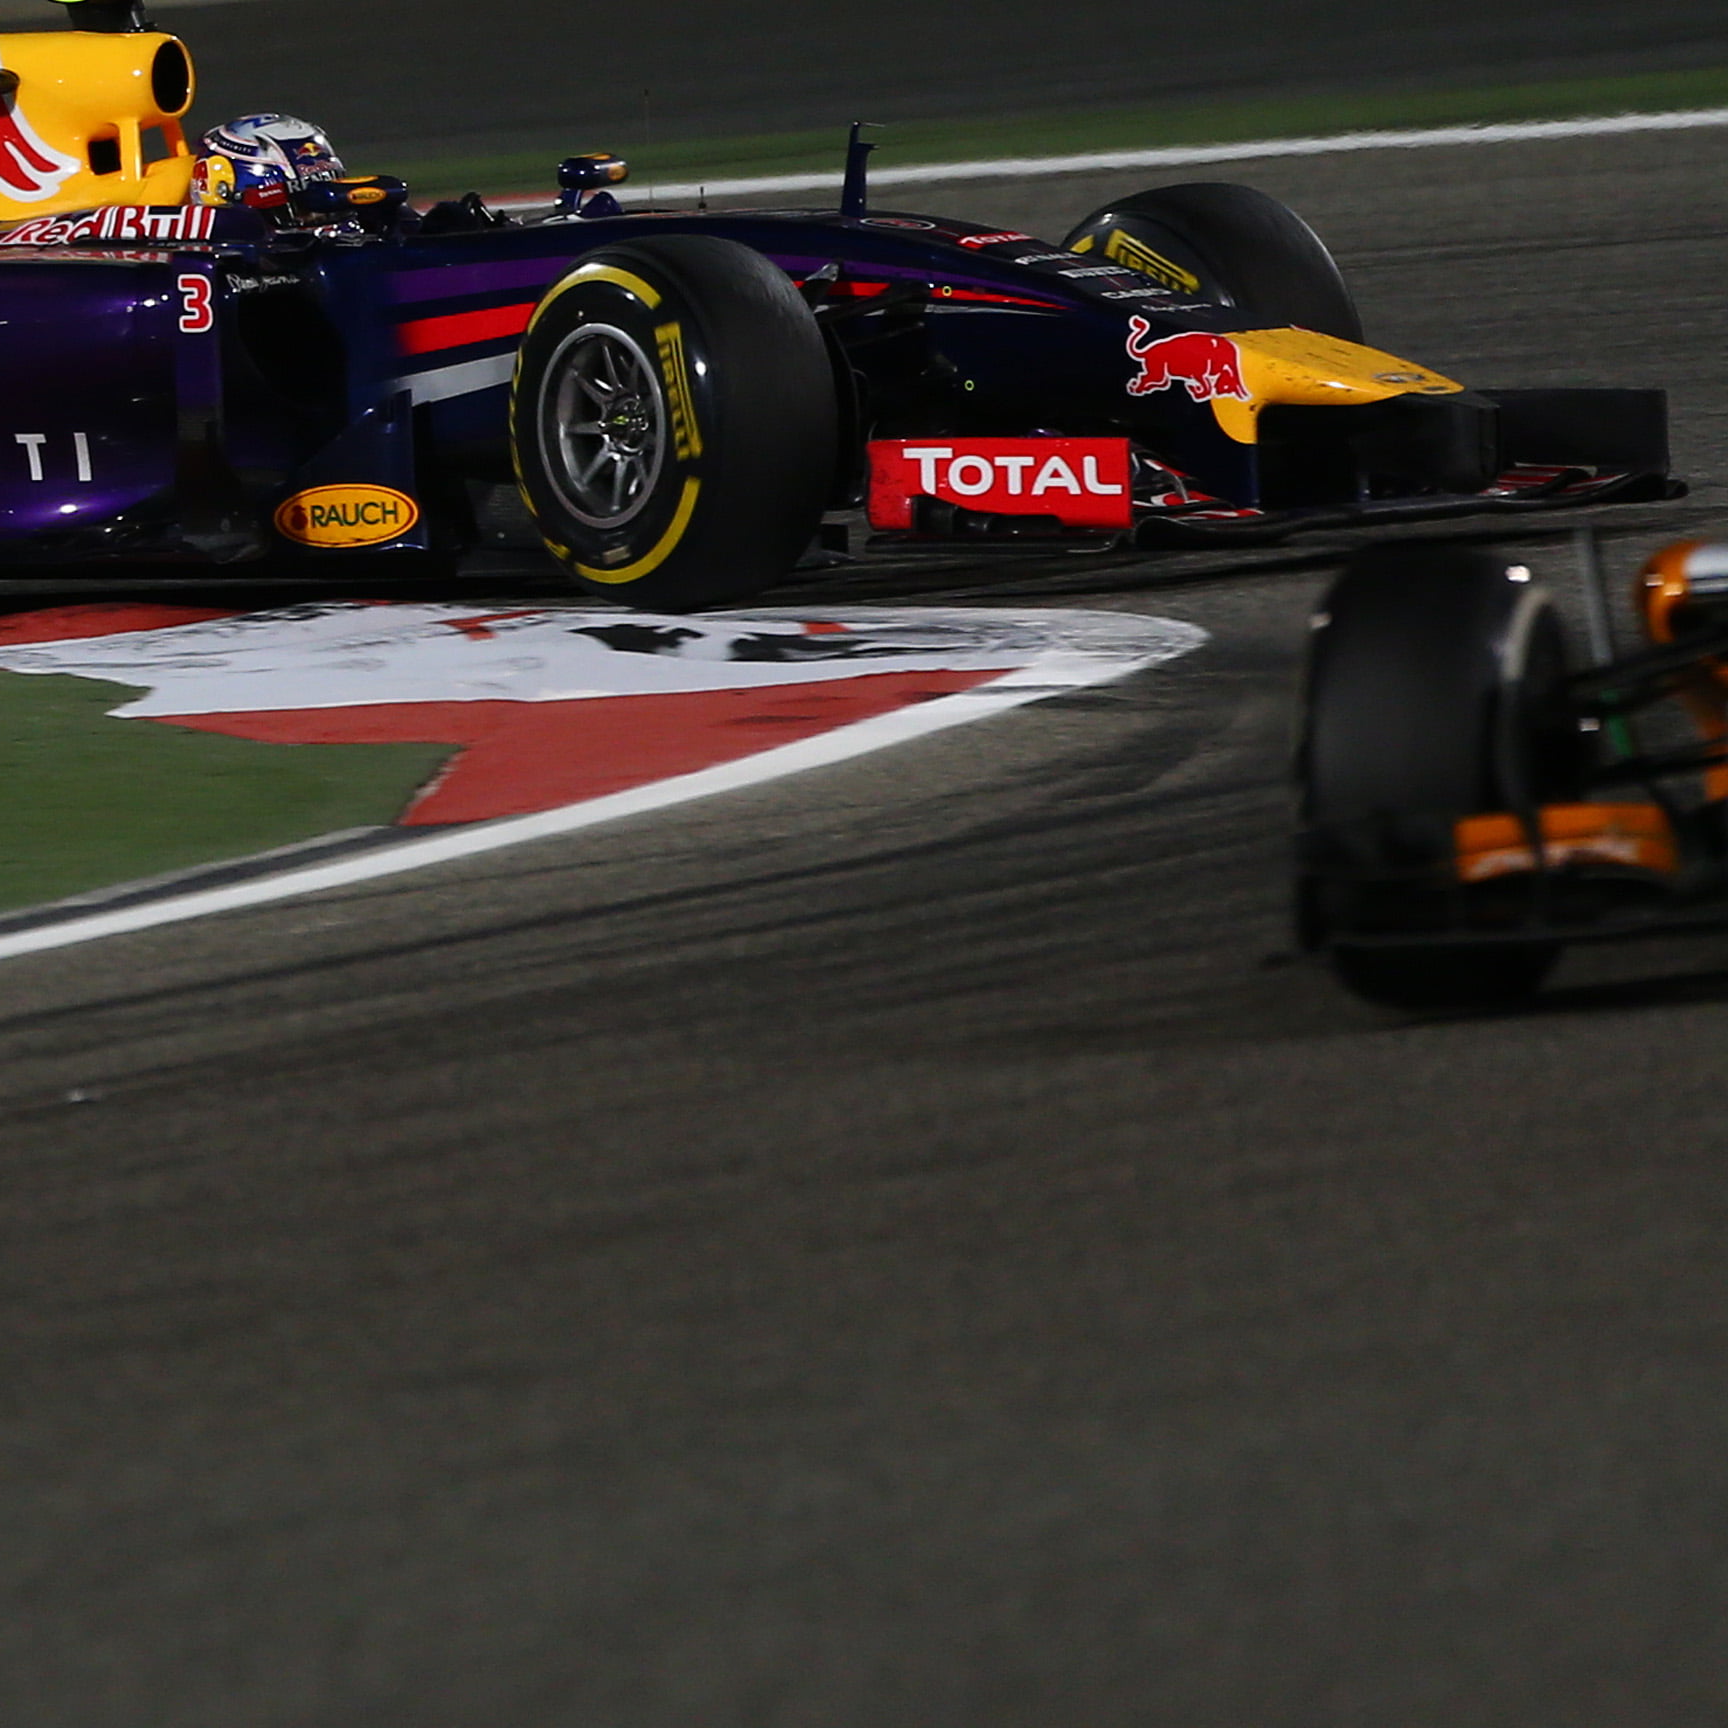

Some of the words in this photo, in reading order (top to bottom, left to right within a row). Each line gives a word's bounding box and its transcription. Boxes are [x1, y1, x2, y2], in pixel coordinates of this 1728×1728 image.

[177, 273, 213, 333] 3
[653, 321, 704, 462] PIRELLI
[901, 446, 1124, 497] TOTAL
[309, 501, 400, 528] RAUCH
